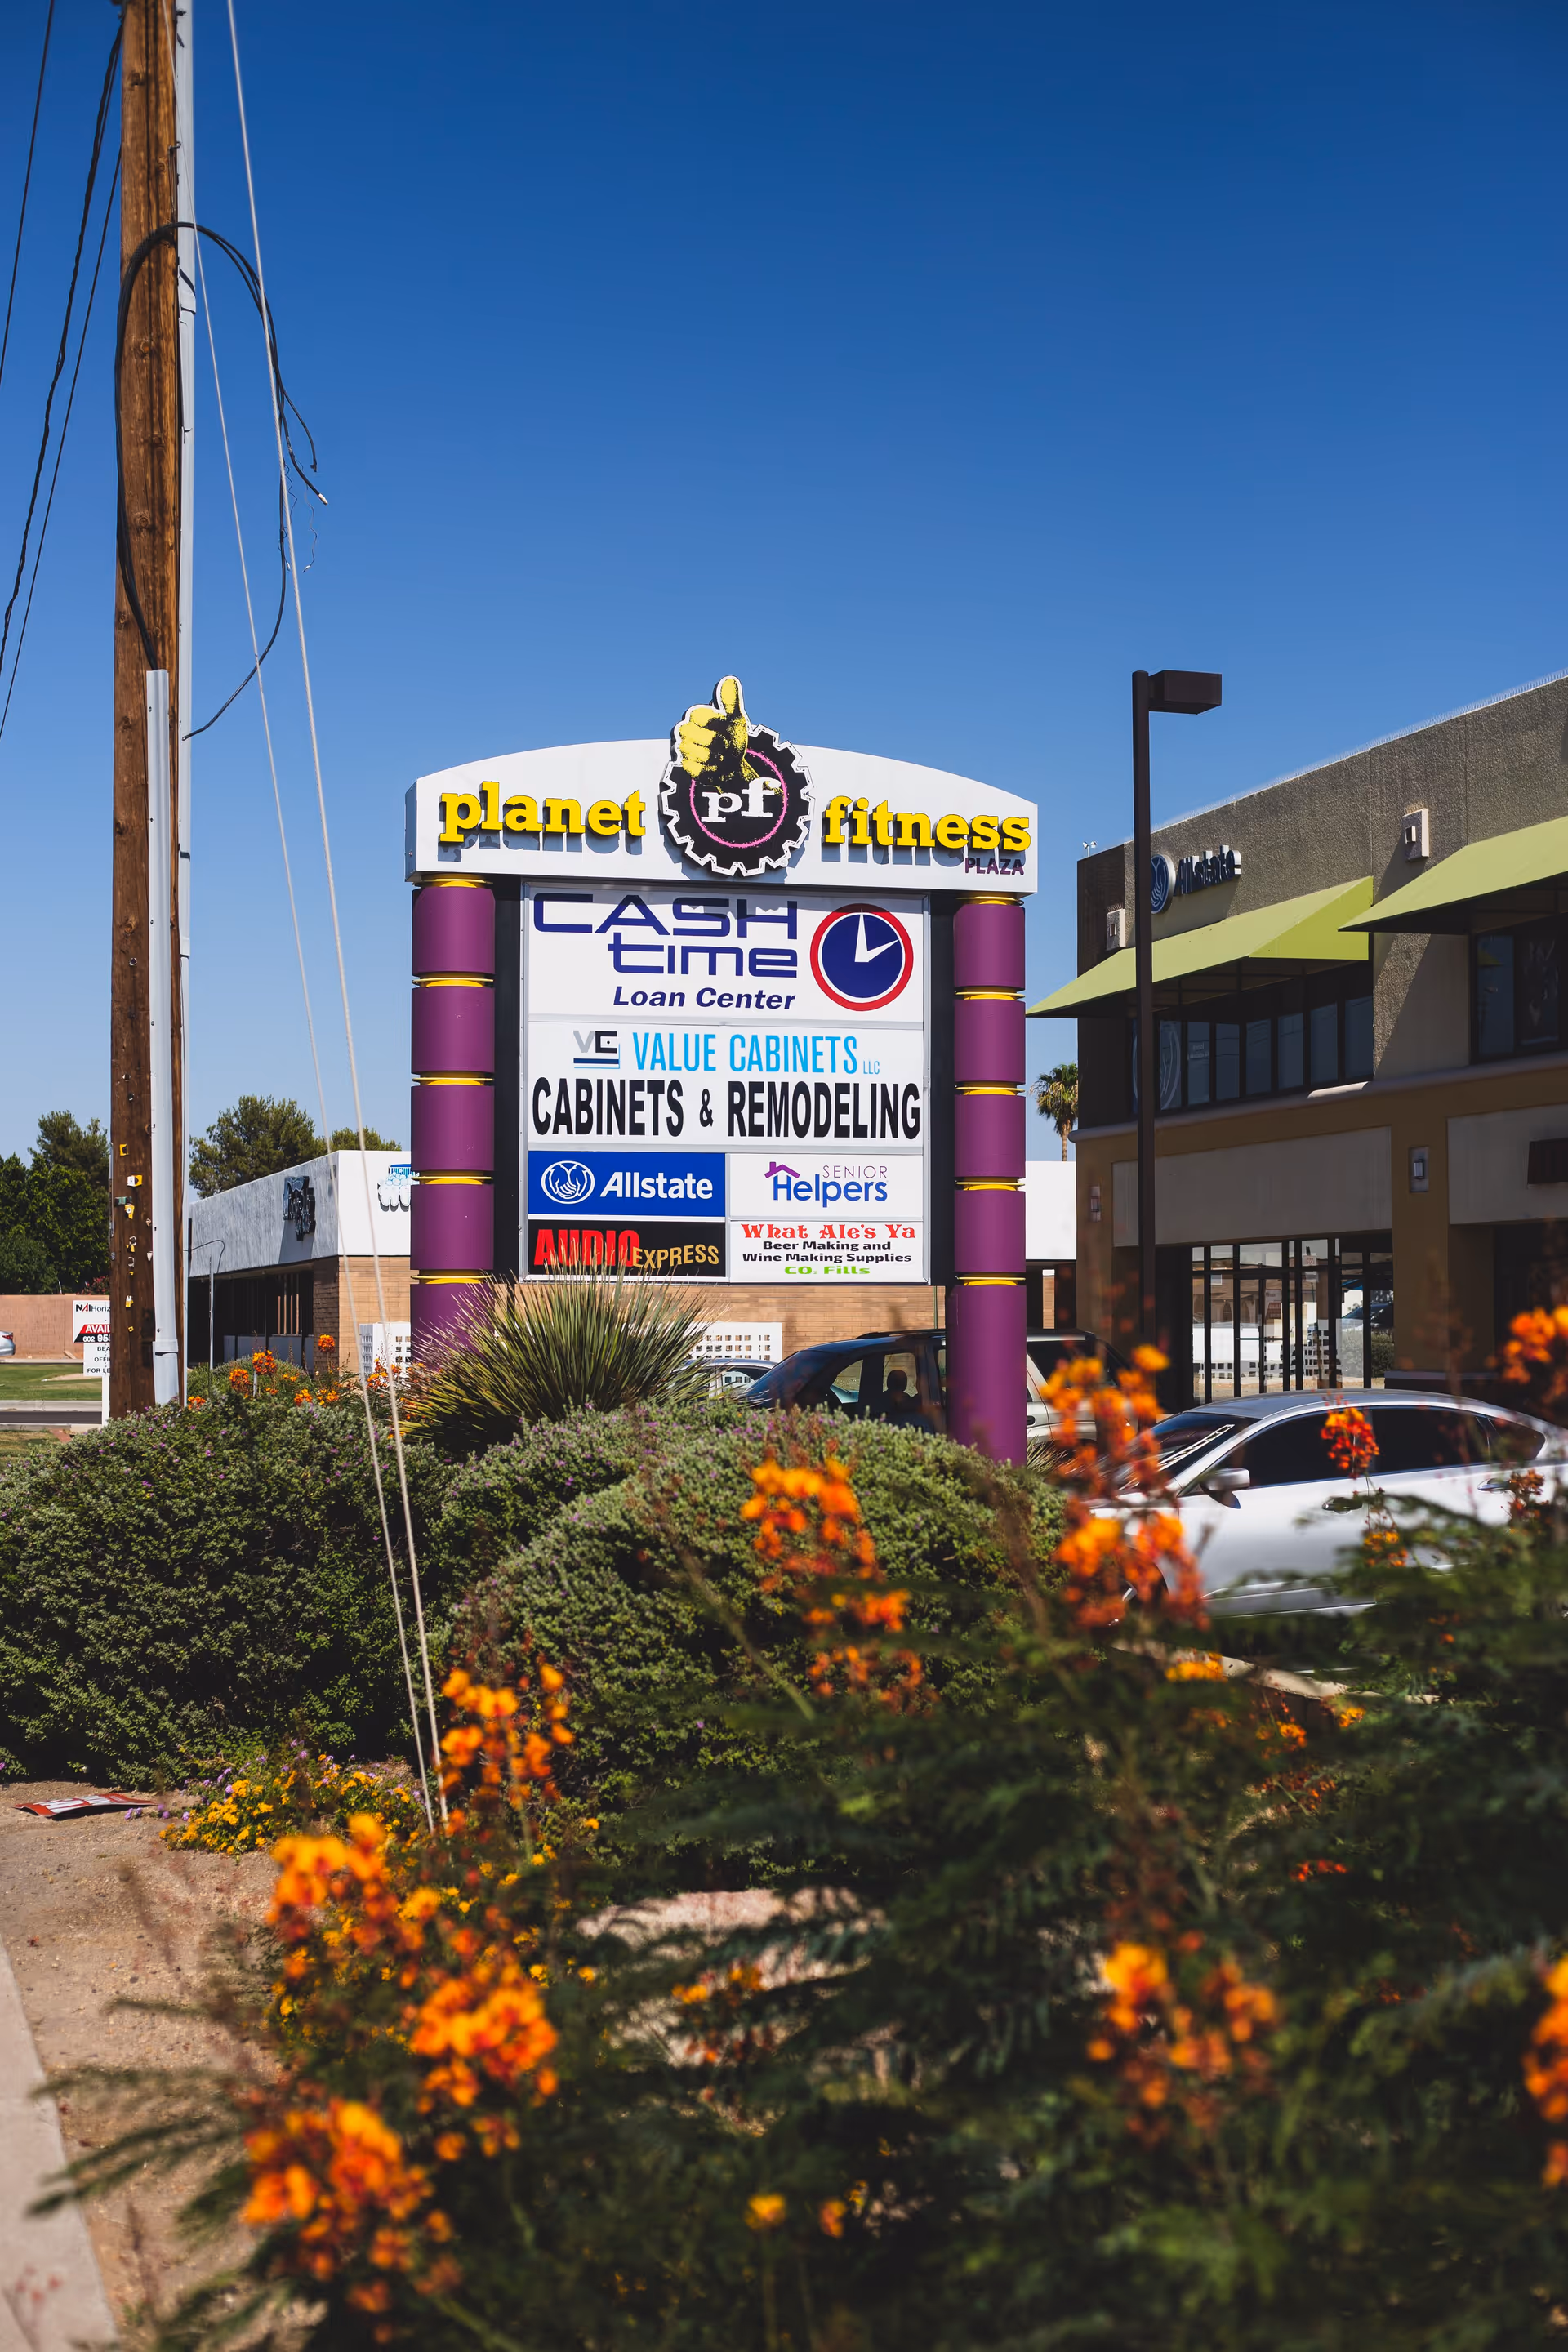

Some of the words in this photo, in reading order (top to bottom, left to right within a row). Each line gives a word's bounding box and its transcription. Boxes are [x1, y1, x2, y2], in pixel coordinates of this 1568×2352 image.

[701, 777, 781, 823] pf
[439, 781, 646, 843] planet
[823, 795, 1031, 851] fitness
[964, 857, 1024, 875] PLAZA
[533, 892, 798, 940] CASH
[608, 931, 798, 978] time
[613, 986, 685, 1007] Loan
[696, 987, 795, 1009] Center
[632, 1031, 716, 1072] VALUE
[729, 1033, 858, 1075] CABINETS
[862, 1060, 880, 1075] LLC
[532, 1076, 684, 1137] CABINETS
[699, 1088, 714, 1128] &
[728, 1080, 920, 1140] REMODELING
[600, 1171, 713, 1199] Allstate
[822, 1165, 888, 1178] SENIOR
[773, 1174, 888, 1208] Helpers
[740, 1223, 808, 1239] What
[818, 1223, 877, 1239] Ale's
[884, 1223, 916, 1239] Ya
[763, 1241, 799, 1250] Beer
[802, 1241, 860, 1251] Making
[862, 1241, 891, 1250] and
[534, 1229, 639, 1267] AUDIO
[632, 1243, 719, 1269] EXPRESS
[742, 1253, 782, 1262] Wine
[786, 1253, 843, 1263] Making
[846, 1253, 911, 1263] Supplies
[823, 1266, 871, 1275] Fills
